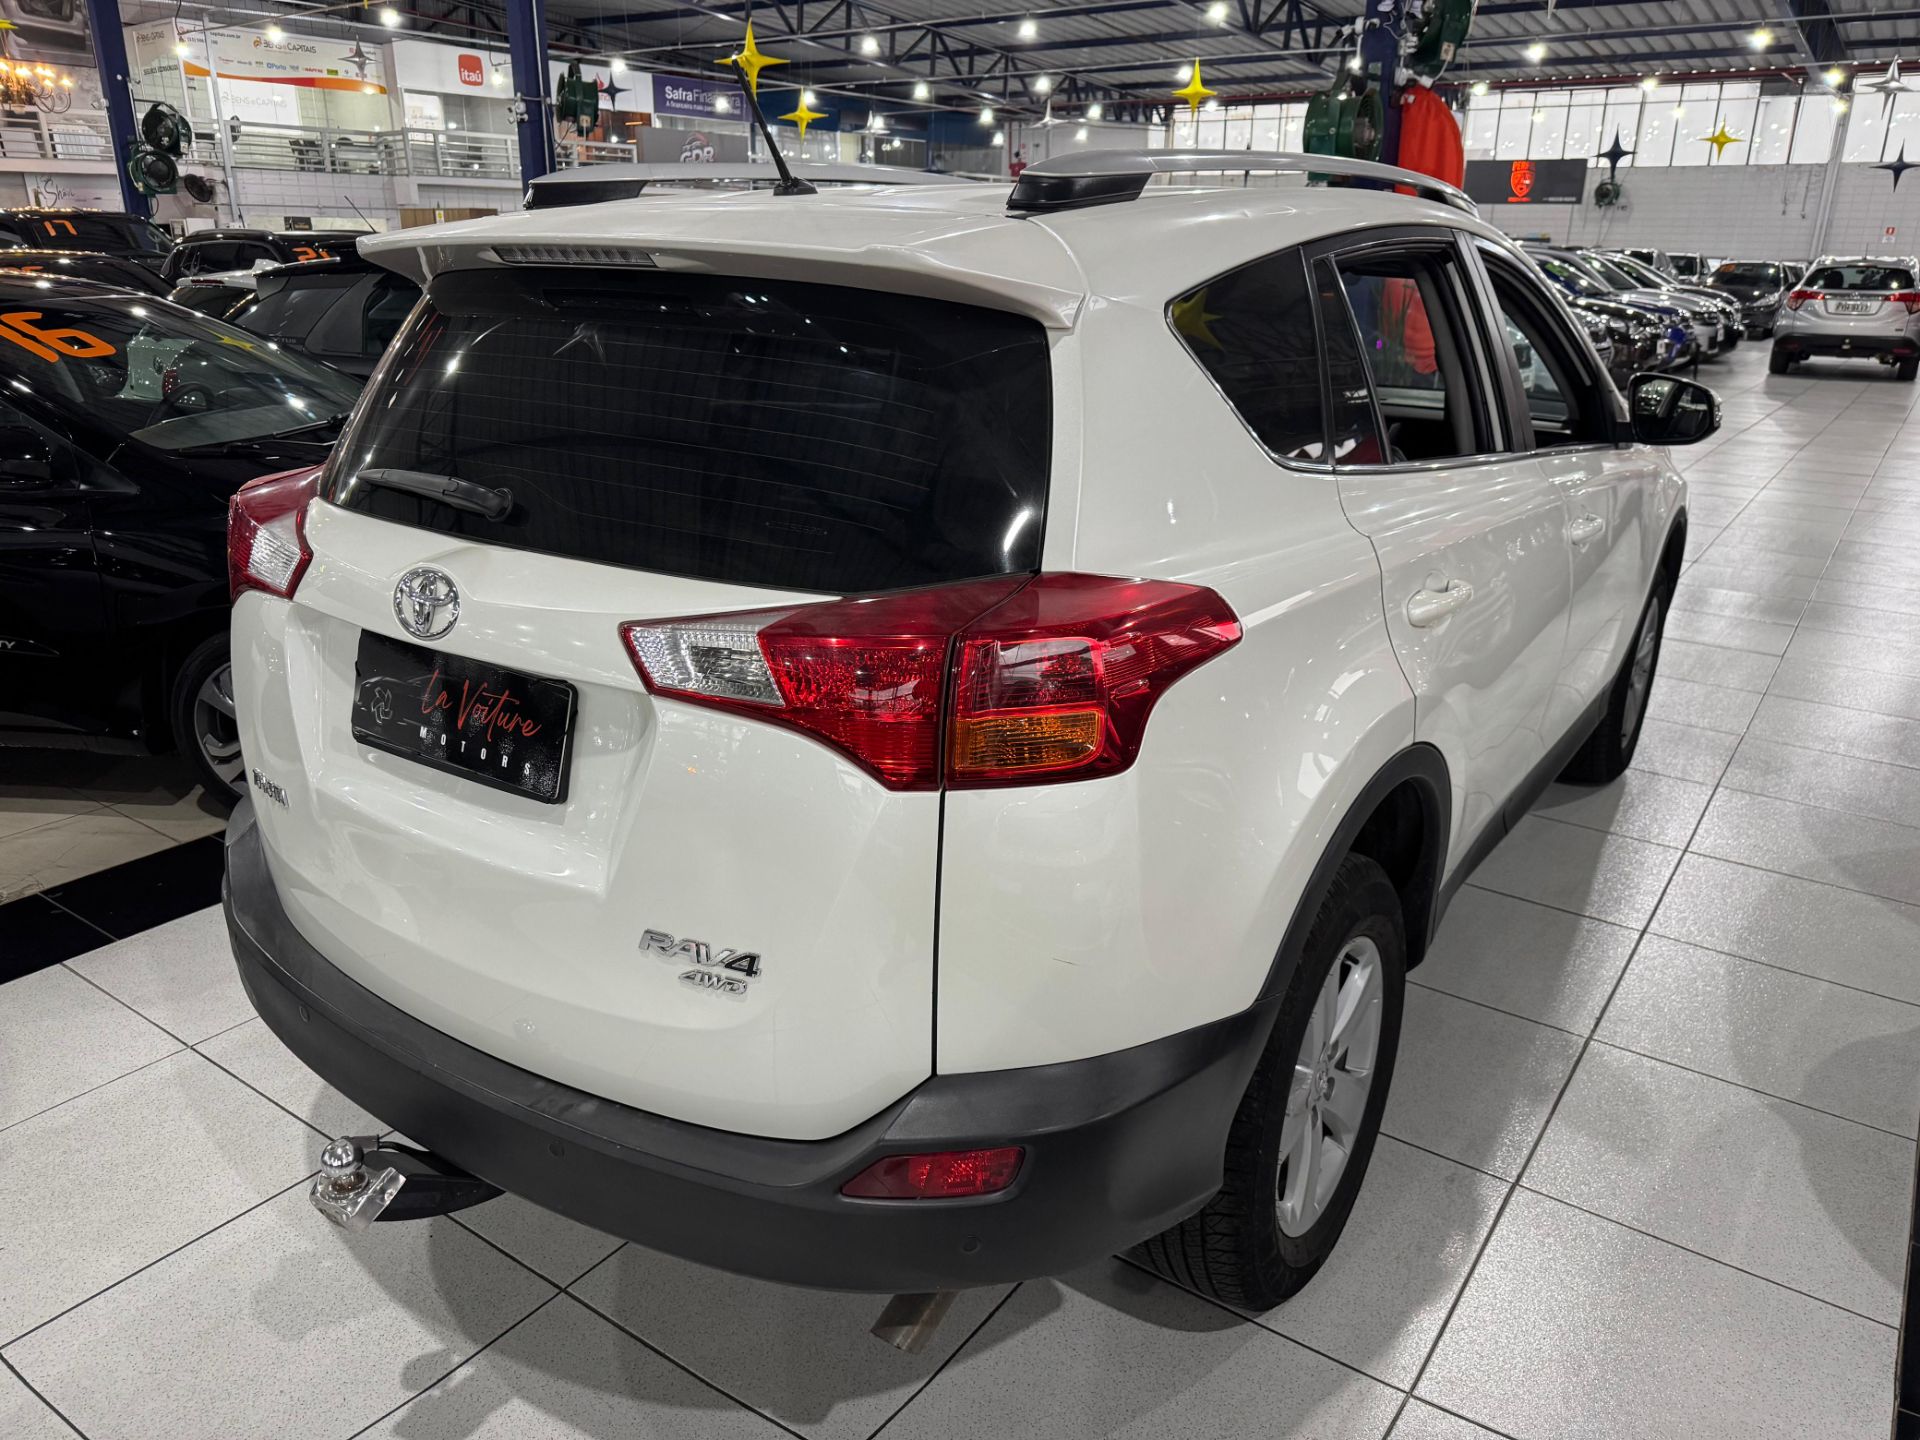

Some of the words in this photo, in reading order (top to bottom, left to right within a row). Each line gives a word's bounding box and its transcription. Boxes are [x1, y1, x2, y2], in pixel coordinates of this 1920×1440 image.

[287, 42, 317, 54] CAPITAIS
[461, 68, 482, 82] itaú
[665, 85, 693, 102] Safra
[44, 220, 78, 237] 17
[0, 311, 117, 363] 16
[421, 669, 453, 714] La
[457, 679, 542, 742] Voiture
[419, 726, 531, 775] MOTORS
[638, 928, 762, 978] RAV4
[677, 969, 748, 995] 4WD
